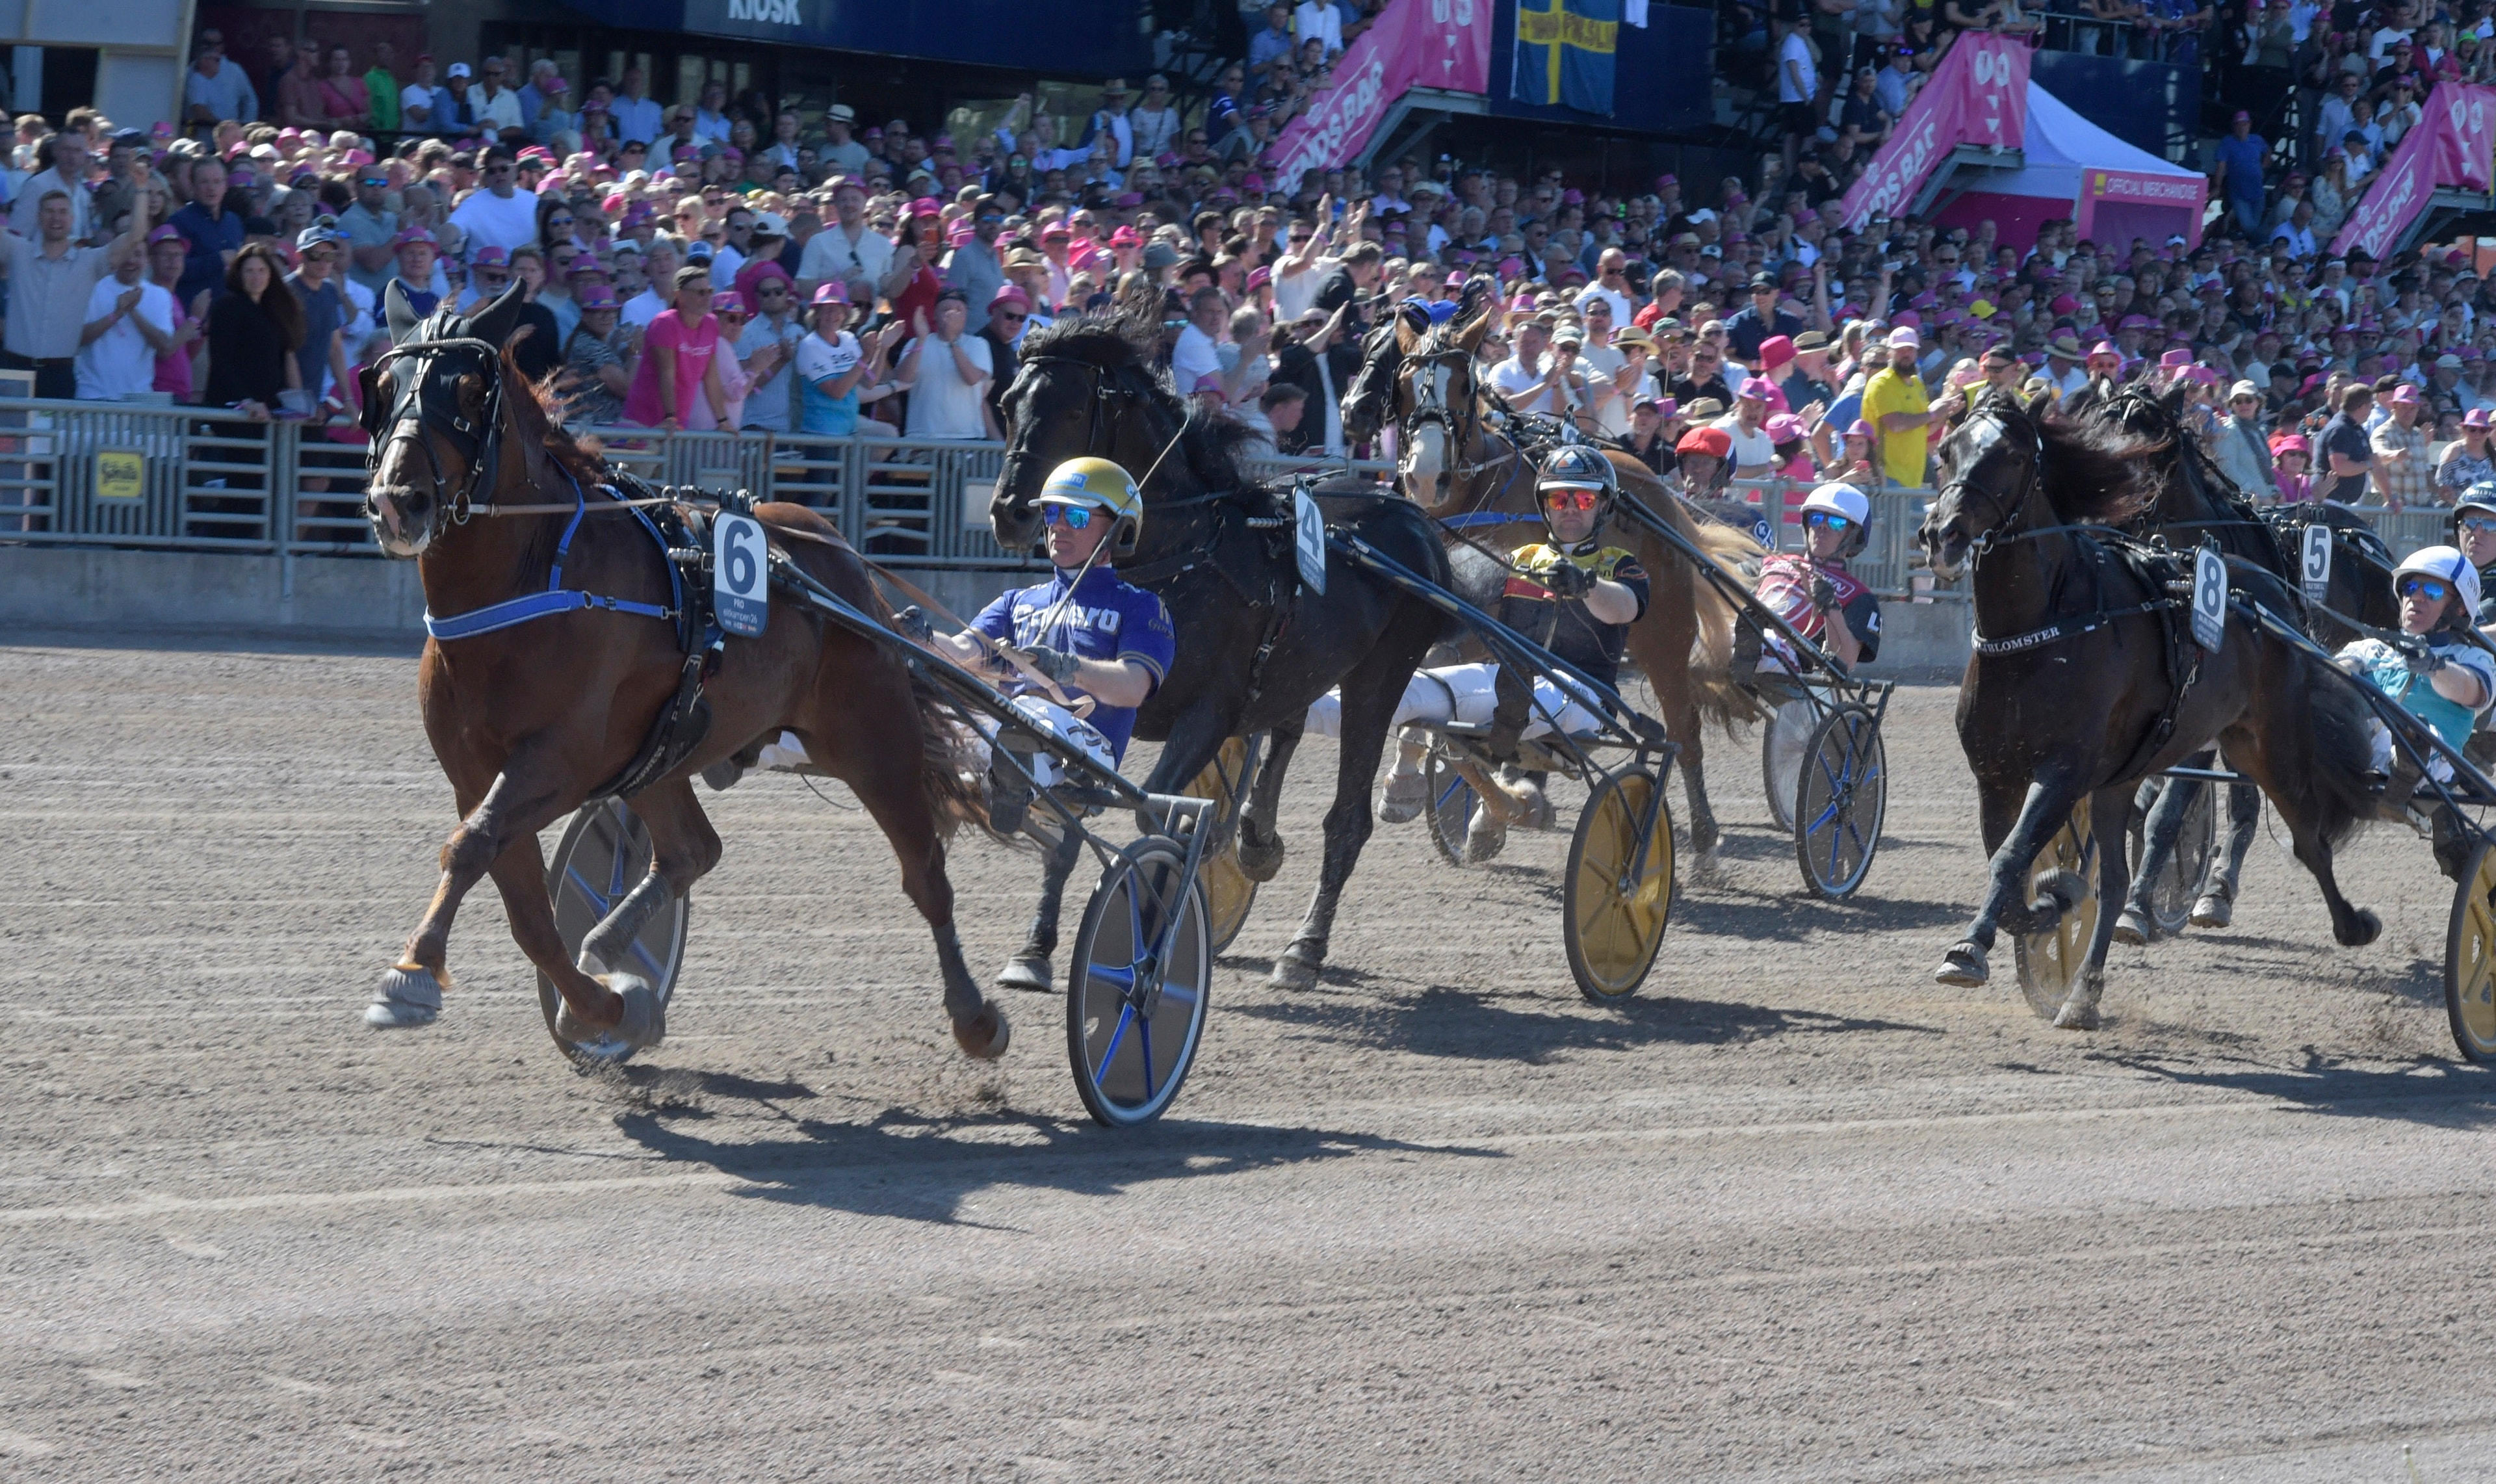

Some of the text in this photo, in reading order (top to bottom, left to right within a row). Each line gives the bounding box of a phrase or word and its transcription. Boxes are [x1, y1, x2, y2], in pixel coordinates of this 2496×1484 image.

[728, 0, 802, 25] KIOSK
[2107, 177, 2141, 195] OFFICIAL
[1302, 501, 1320, 560] 4
[2308, 528, 2326, 579] 5
[723, 520, 756, 595] 6
[734, 597, 744, 610] PRO
[2202, 556, 2221, 617] 8
